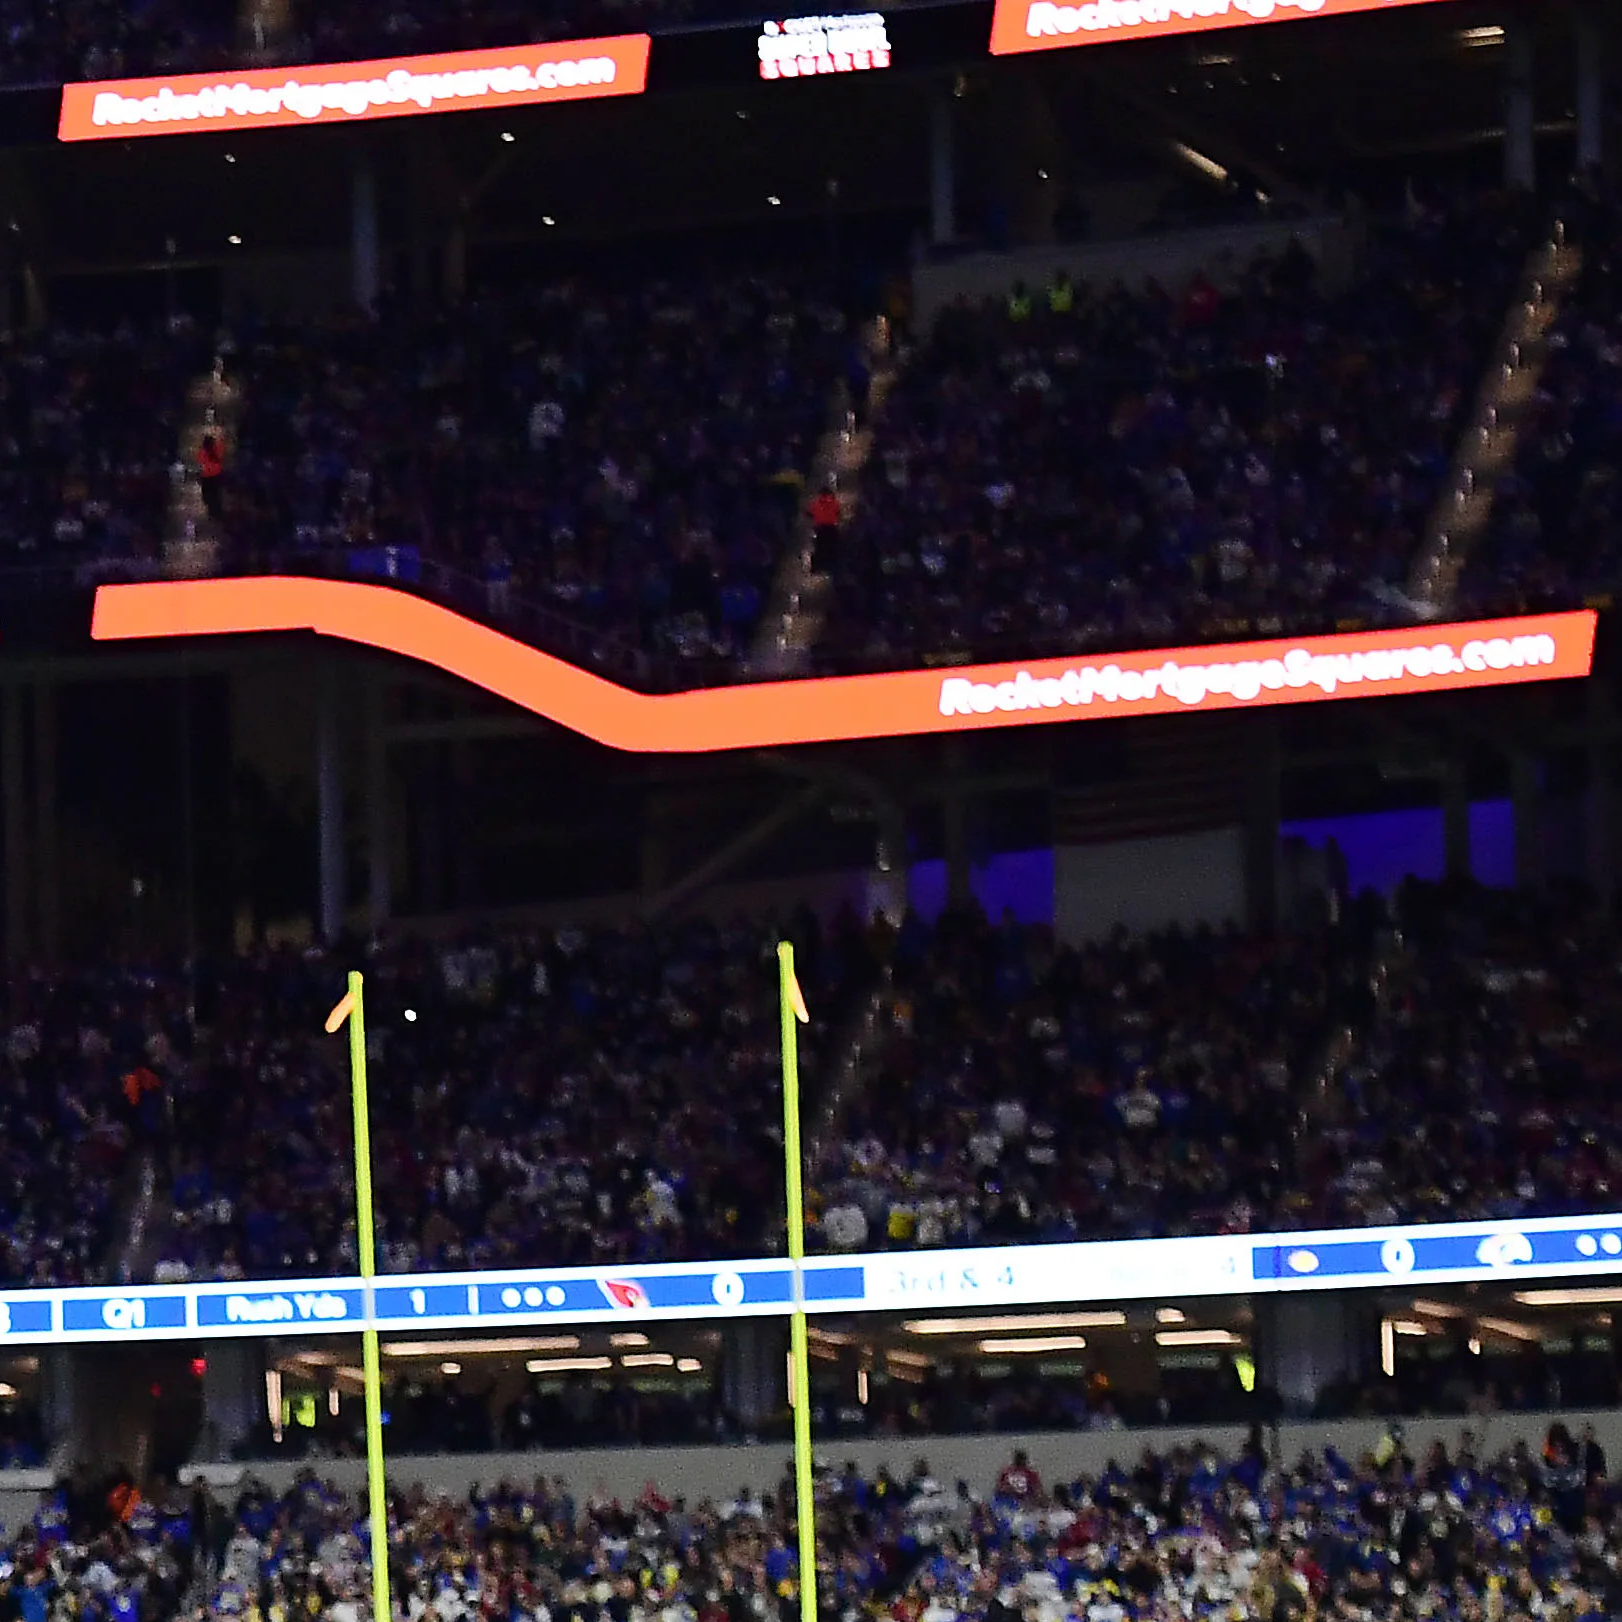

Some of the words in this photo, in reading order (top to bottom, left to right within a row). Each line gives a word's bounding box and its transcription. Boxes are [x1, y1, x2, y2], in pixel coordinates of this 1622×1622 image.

[996, 1265, 1016, 1287] 4
[103, 1298, 146, 1329] Q1
[409, 1288, 426, 1315] 1
